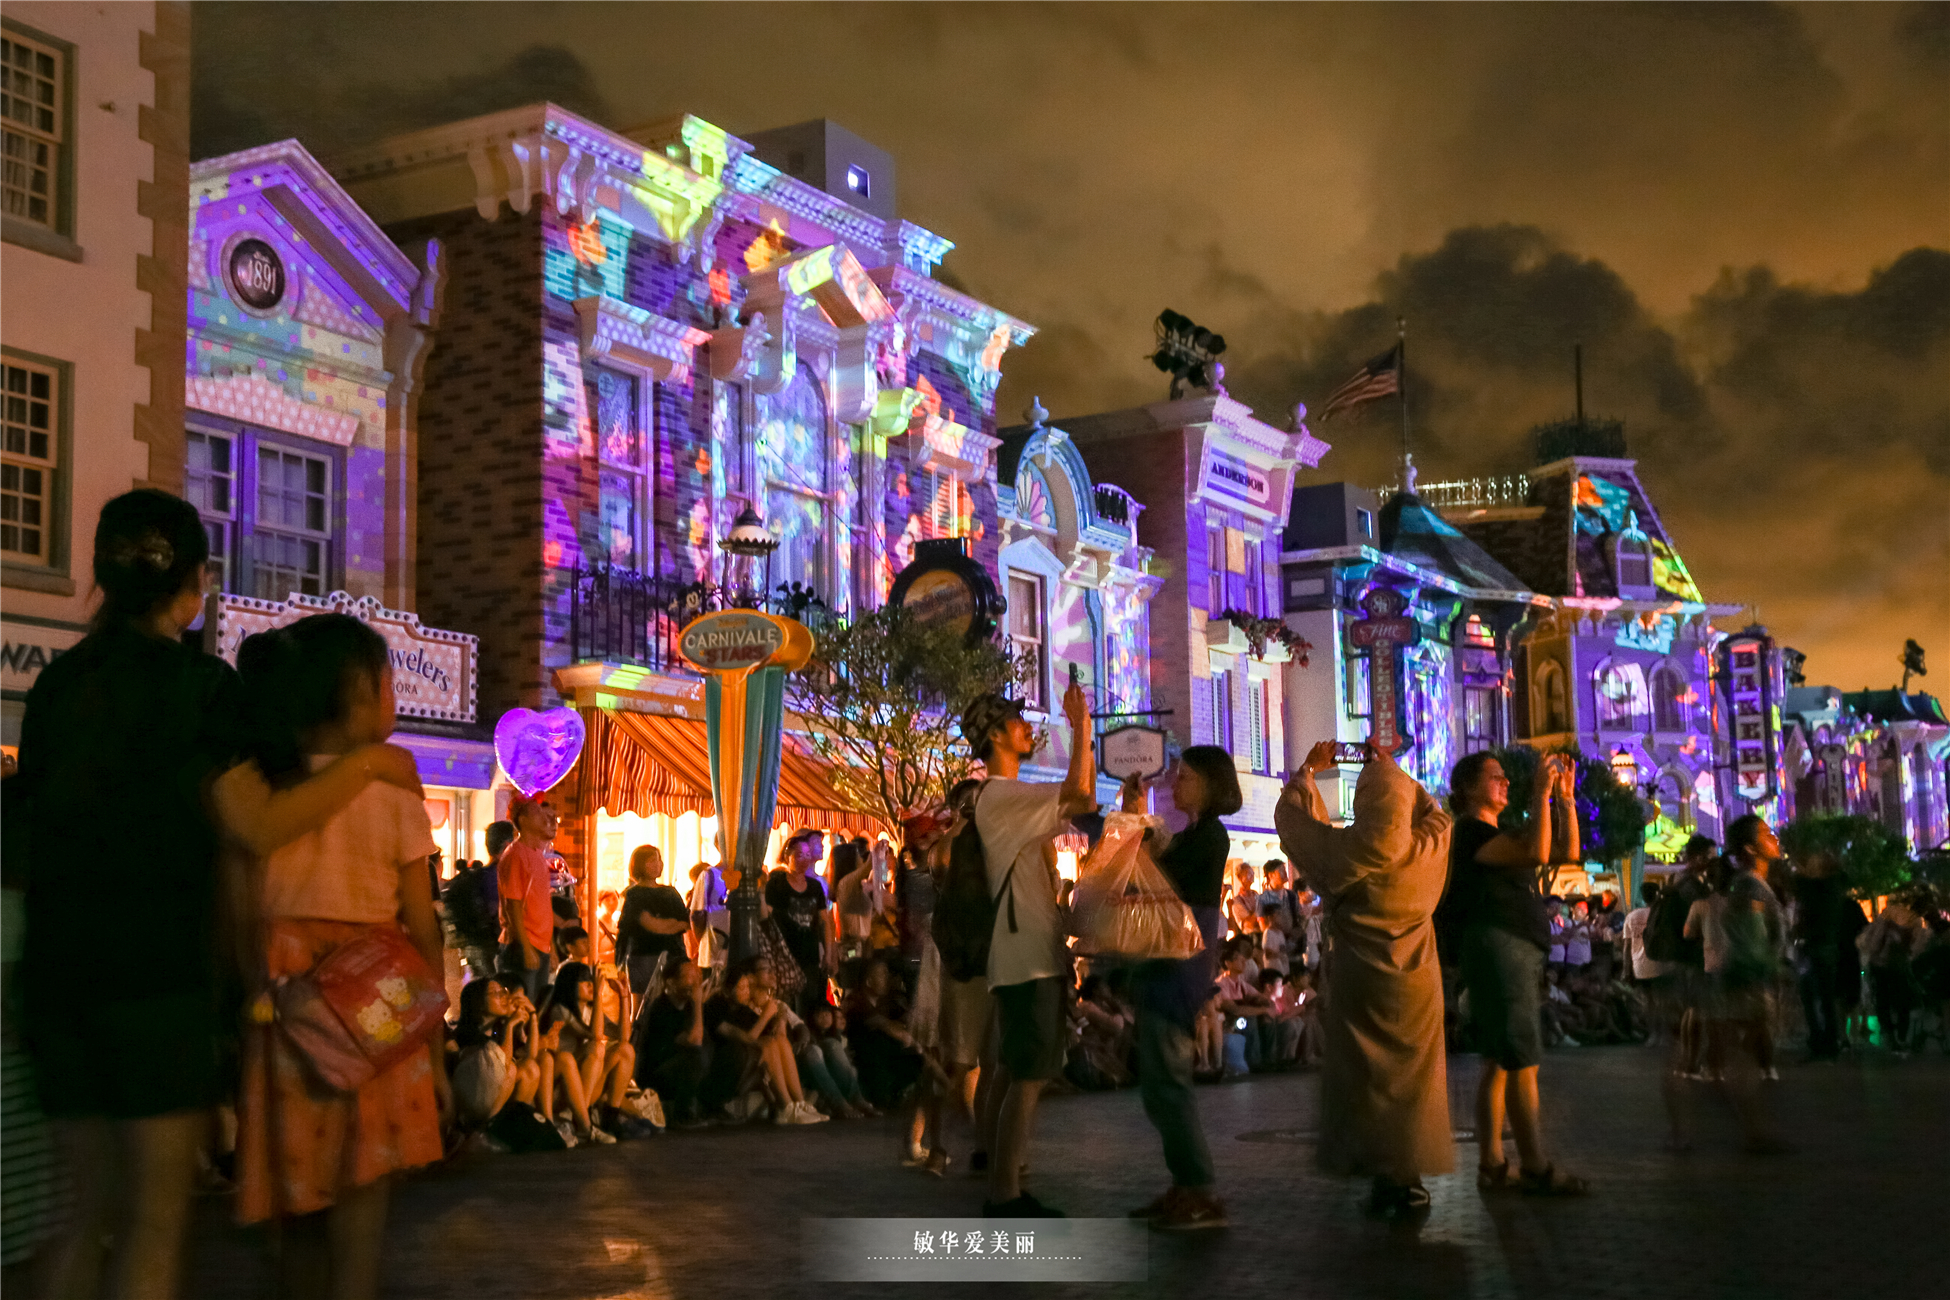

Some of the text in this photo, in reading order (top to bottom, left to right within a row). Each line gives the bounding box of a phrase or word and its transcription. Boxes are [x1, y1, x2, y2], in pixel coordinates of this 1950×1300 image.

[247, 259, 277, 295] 1891
[1211, 461, 1264, 494] ANDERSON
[685, 628, 777, 649] CARNIVALE
[392, 681, 418, 695] ORA
[1734, 652, 1763, 787] BAKERY
[1113, 755, 1154, 765] PANDORA
